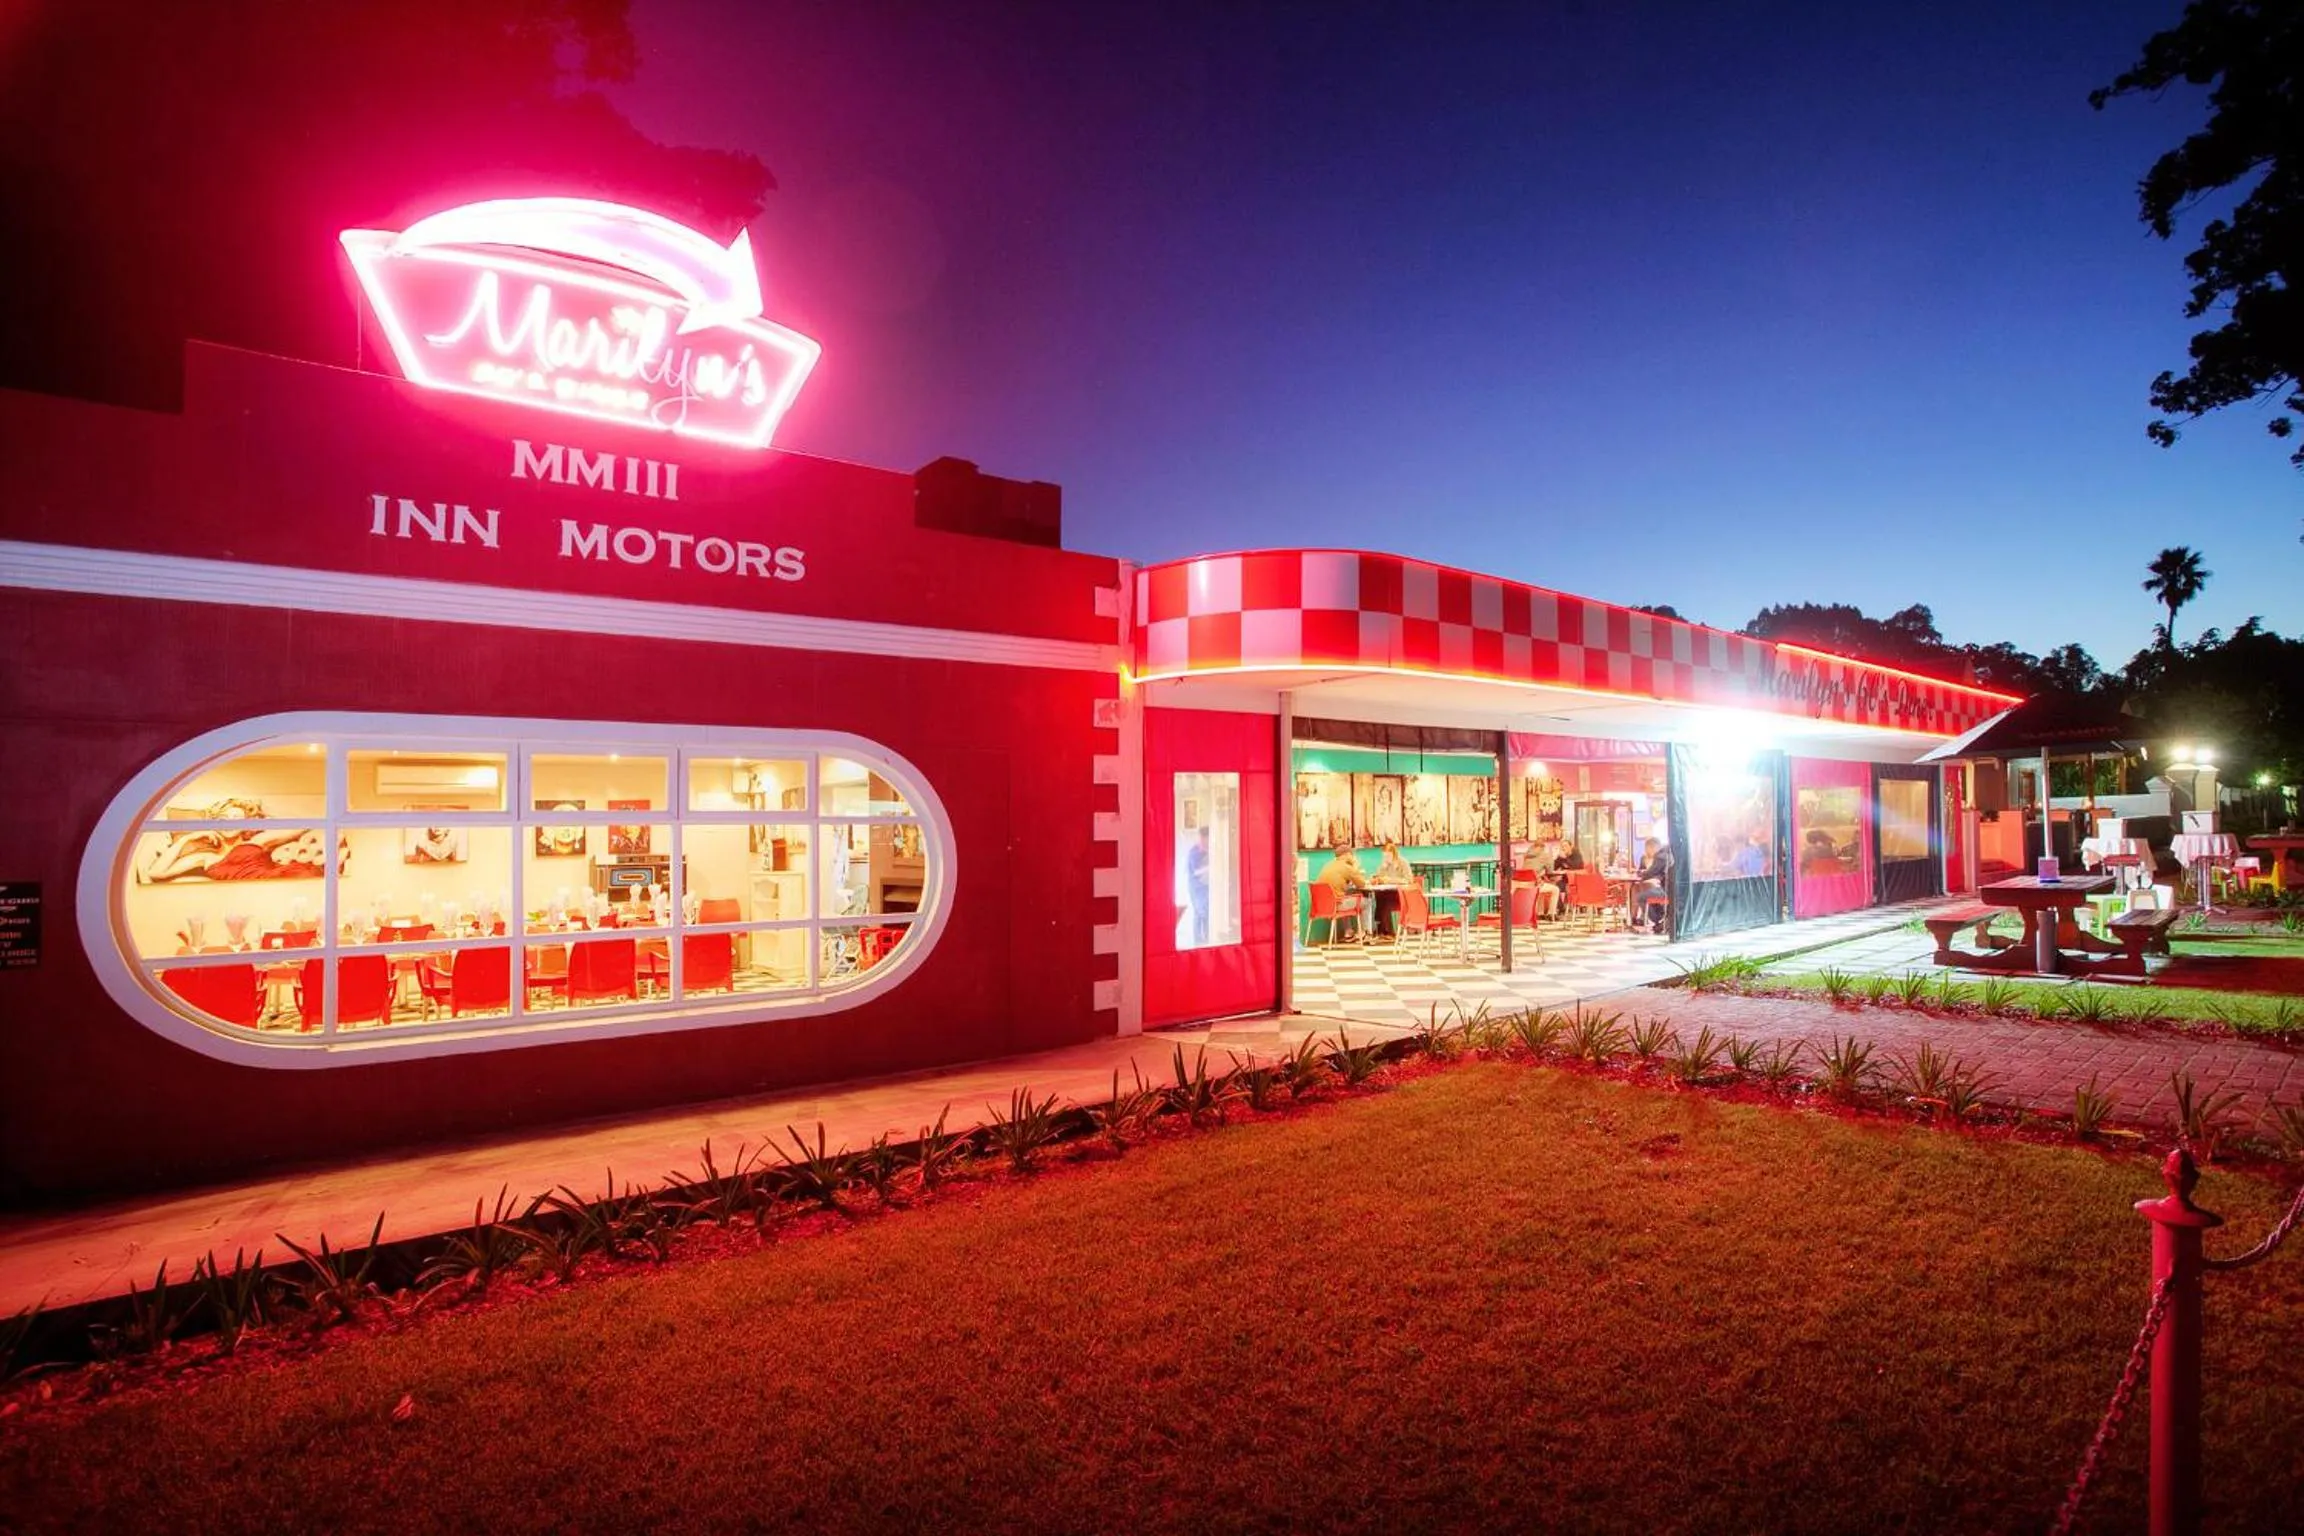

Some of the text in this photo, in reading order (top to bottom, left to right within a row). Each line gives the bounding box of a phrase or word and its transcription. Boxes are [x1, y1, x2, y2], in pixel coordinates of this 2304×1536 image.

[424, 269, 766, 430] Marilyn's
[369, 494, 807, 582] INN MOTORS
